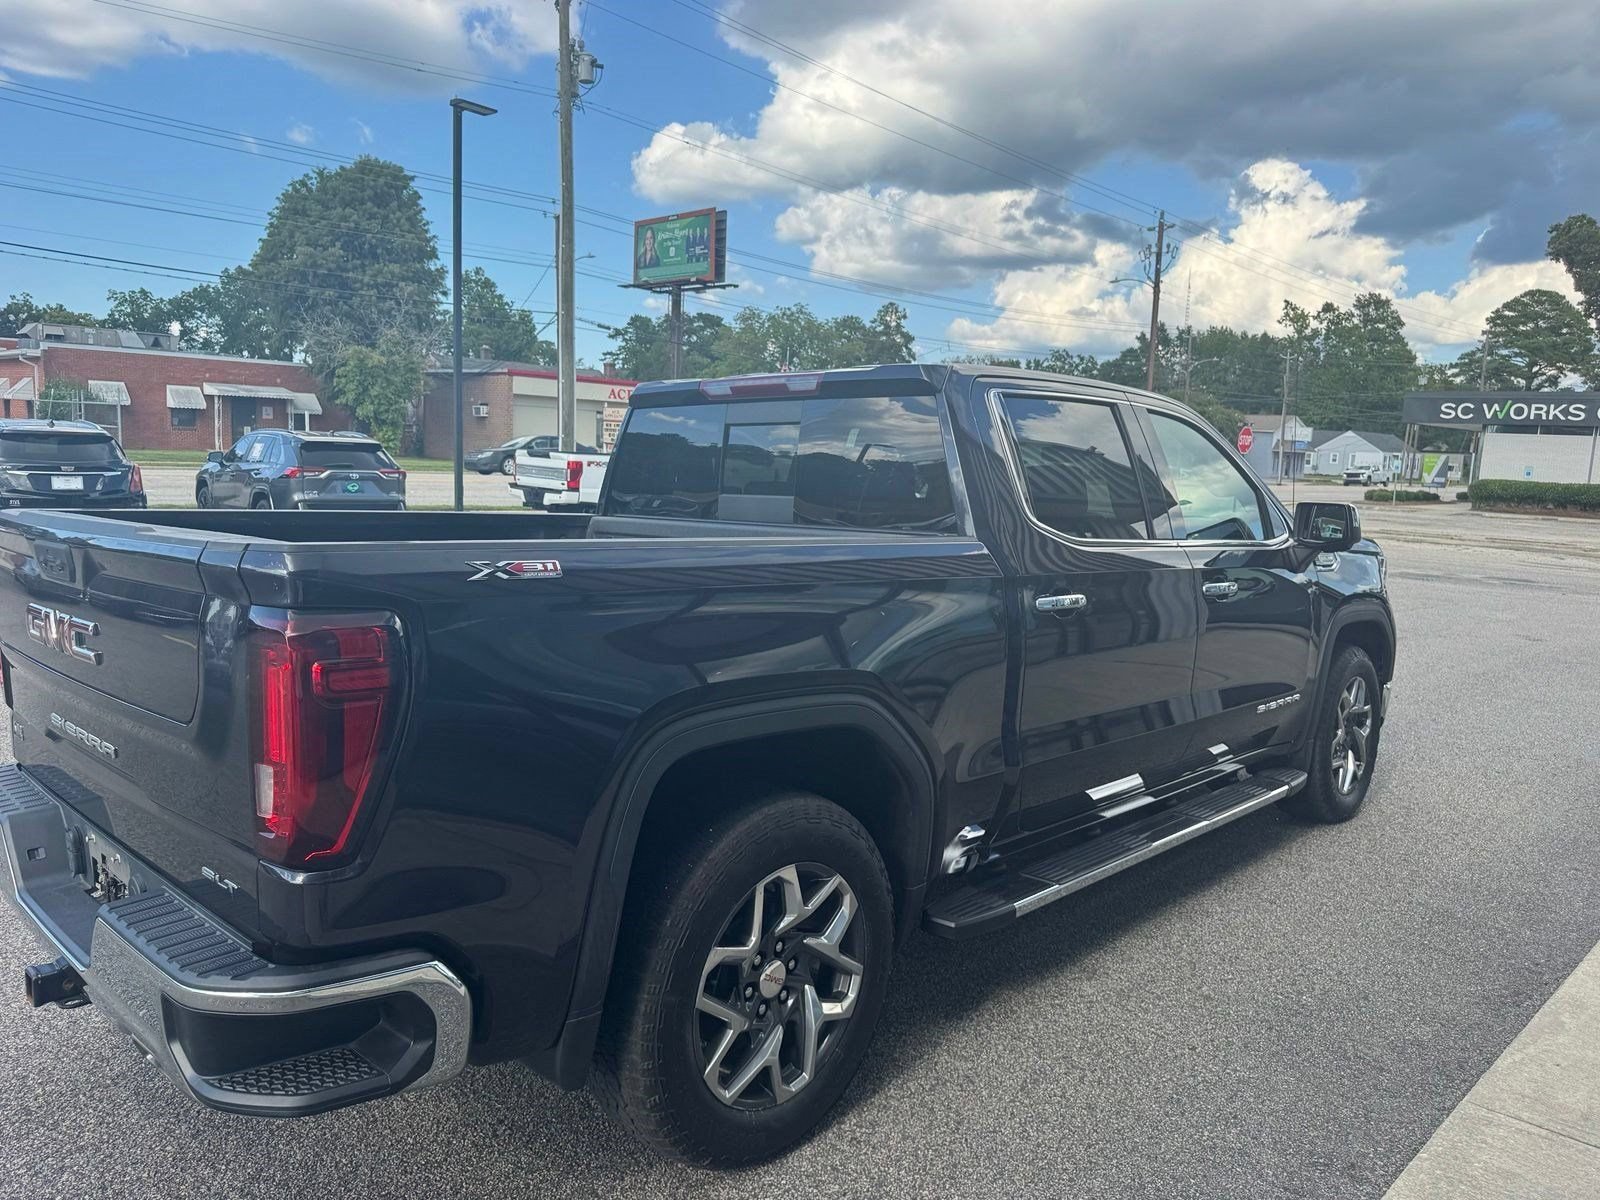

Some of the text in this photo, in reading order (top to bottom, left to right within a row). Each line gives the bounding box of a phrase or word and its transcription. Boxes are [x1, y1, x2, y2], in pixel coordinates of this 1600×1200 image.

[1439, 402, 1475, 420] SC
[1482, 400, 1587, 421] WORKS
[1239, 435, 1252, 446] STOP
[464, 559, 563, 582] X31
[26, 602, 105, 666] GMC
[1256, 693, 1301, 714] SIERRA
[50, 712, 119, 759] SIERRA
[201, 866, 238, 894] SLT
